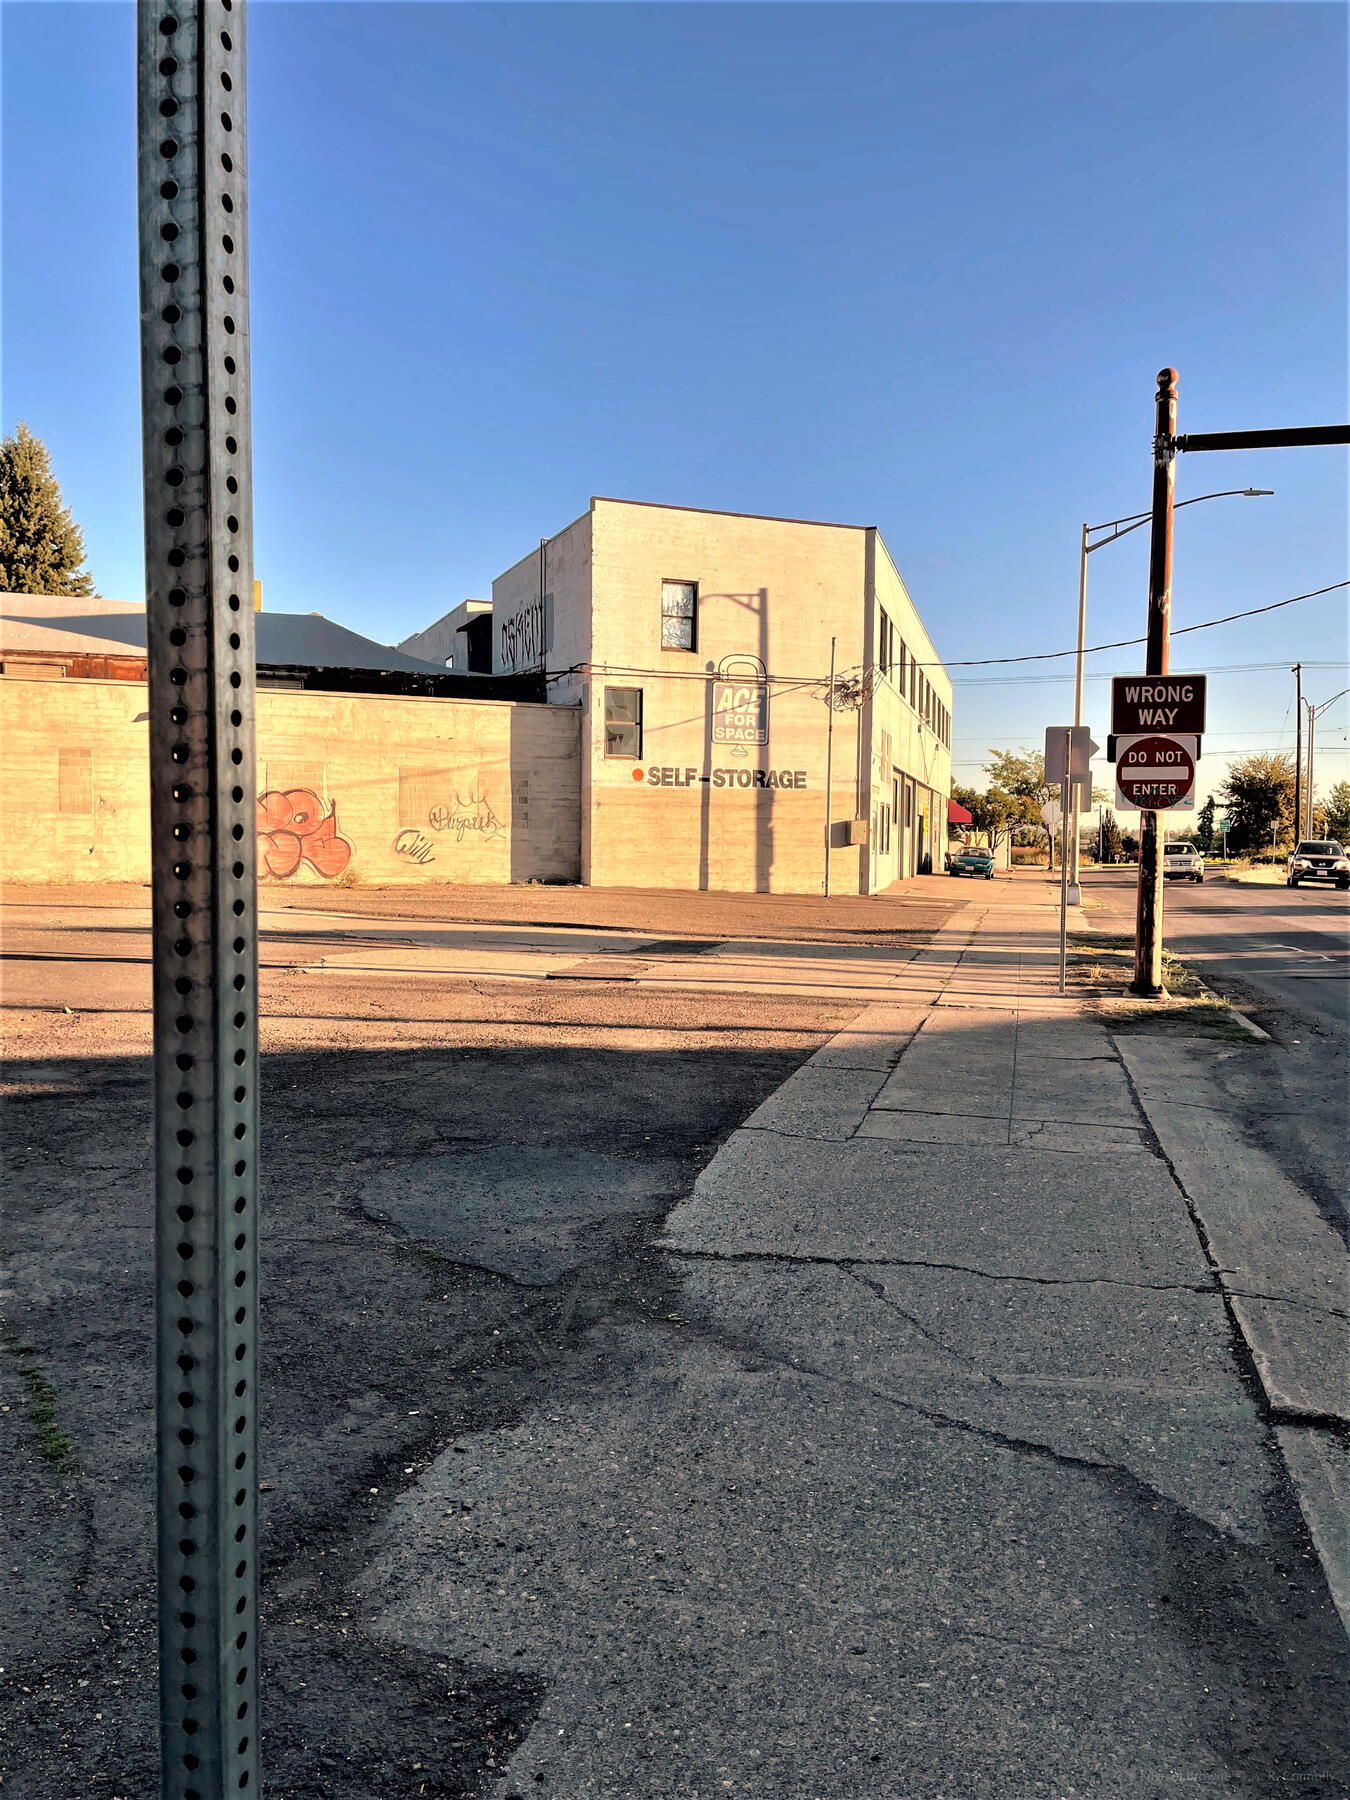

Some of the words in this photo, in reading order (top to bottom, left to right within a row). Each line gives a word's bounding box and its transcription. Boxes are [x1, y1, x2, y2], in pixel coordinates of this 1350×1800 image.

[717, 686, 765, 714] ACE
[1125, 685, 1194, 703] WRONG
[725, 714, 757, 726] FOR
[1138, 708, 1179, 725] WAY
[716, 727, 765, 740] SPACE
[1128, 751, 1147, 763] DO
[1155, 751, 1183, 763] NOT
[1133, 784, 1177, 796] ENTER
